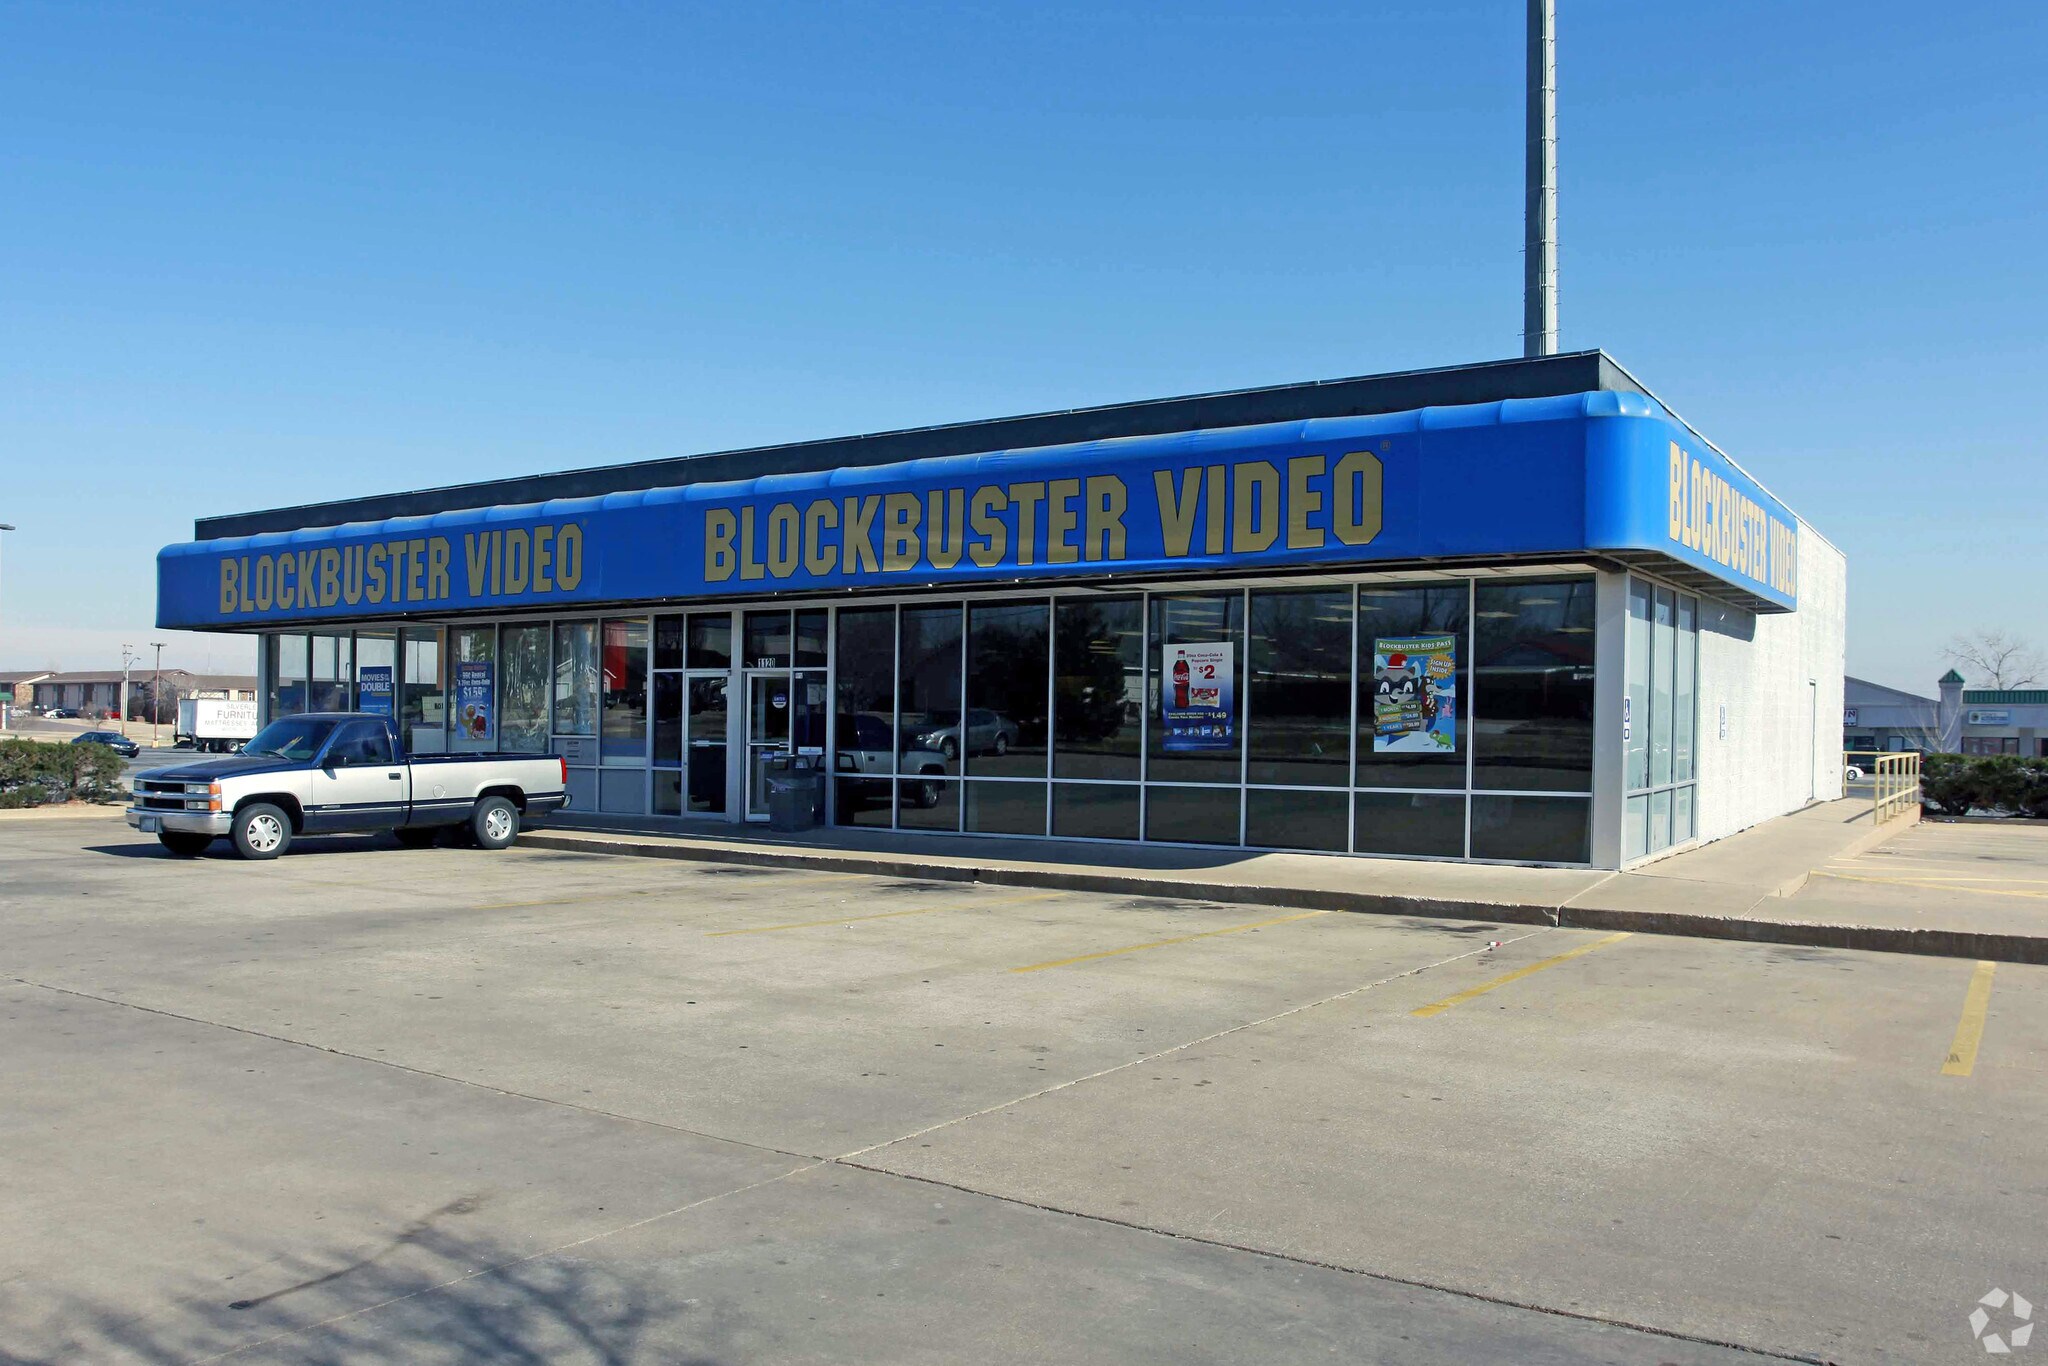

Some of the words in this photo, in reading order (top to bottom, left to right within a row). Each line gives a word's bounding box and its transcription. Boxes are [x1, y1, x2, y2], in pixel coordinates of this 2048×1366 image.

[704, 474, 1128, 583] BLOCKBUSTER
[1153, 451, 1384, 557] VIDEO
[1670, 440, 1767, 584] BLOCKBUSTER
[1769, 515, 1797, 599] VIDEO
[219, 535, 451, 614] BLOCKBUSTER
[464, 523, 584, 597] VIDEO
[1436, 640, 1452, 648] PASS
[361, 682, 390, 692] DOUBLE
[1199, 664, 1215, 679] $2
